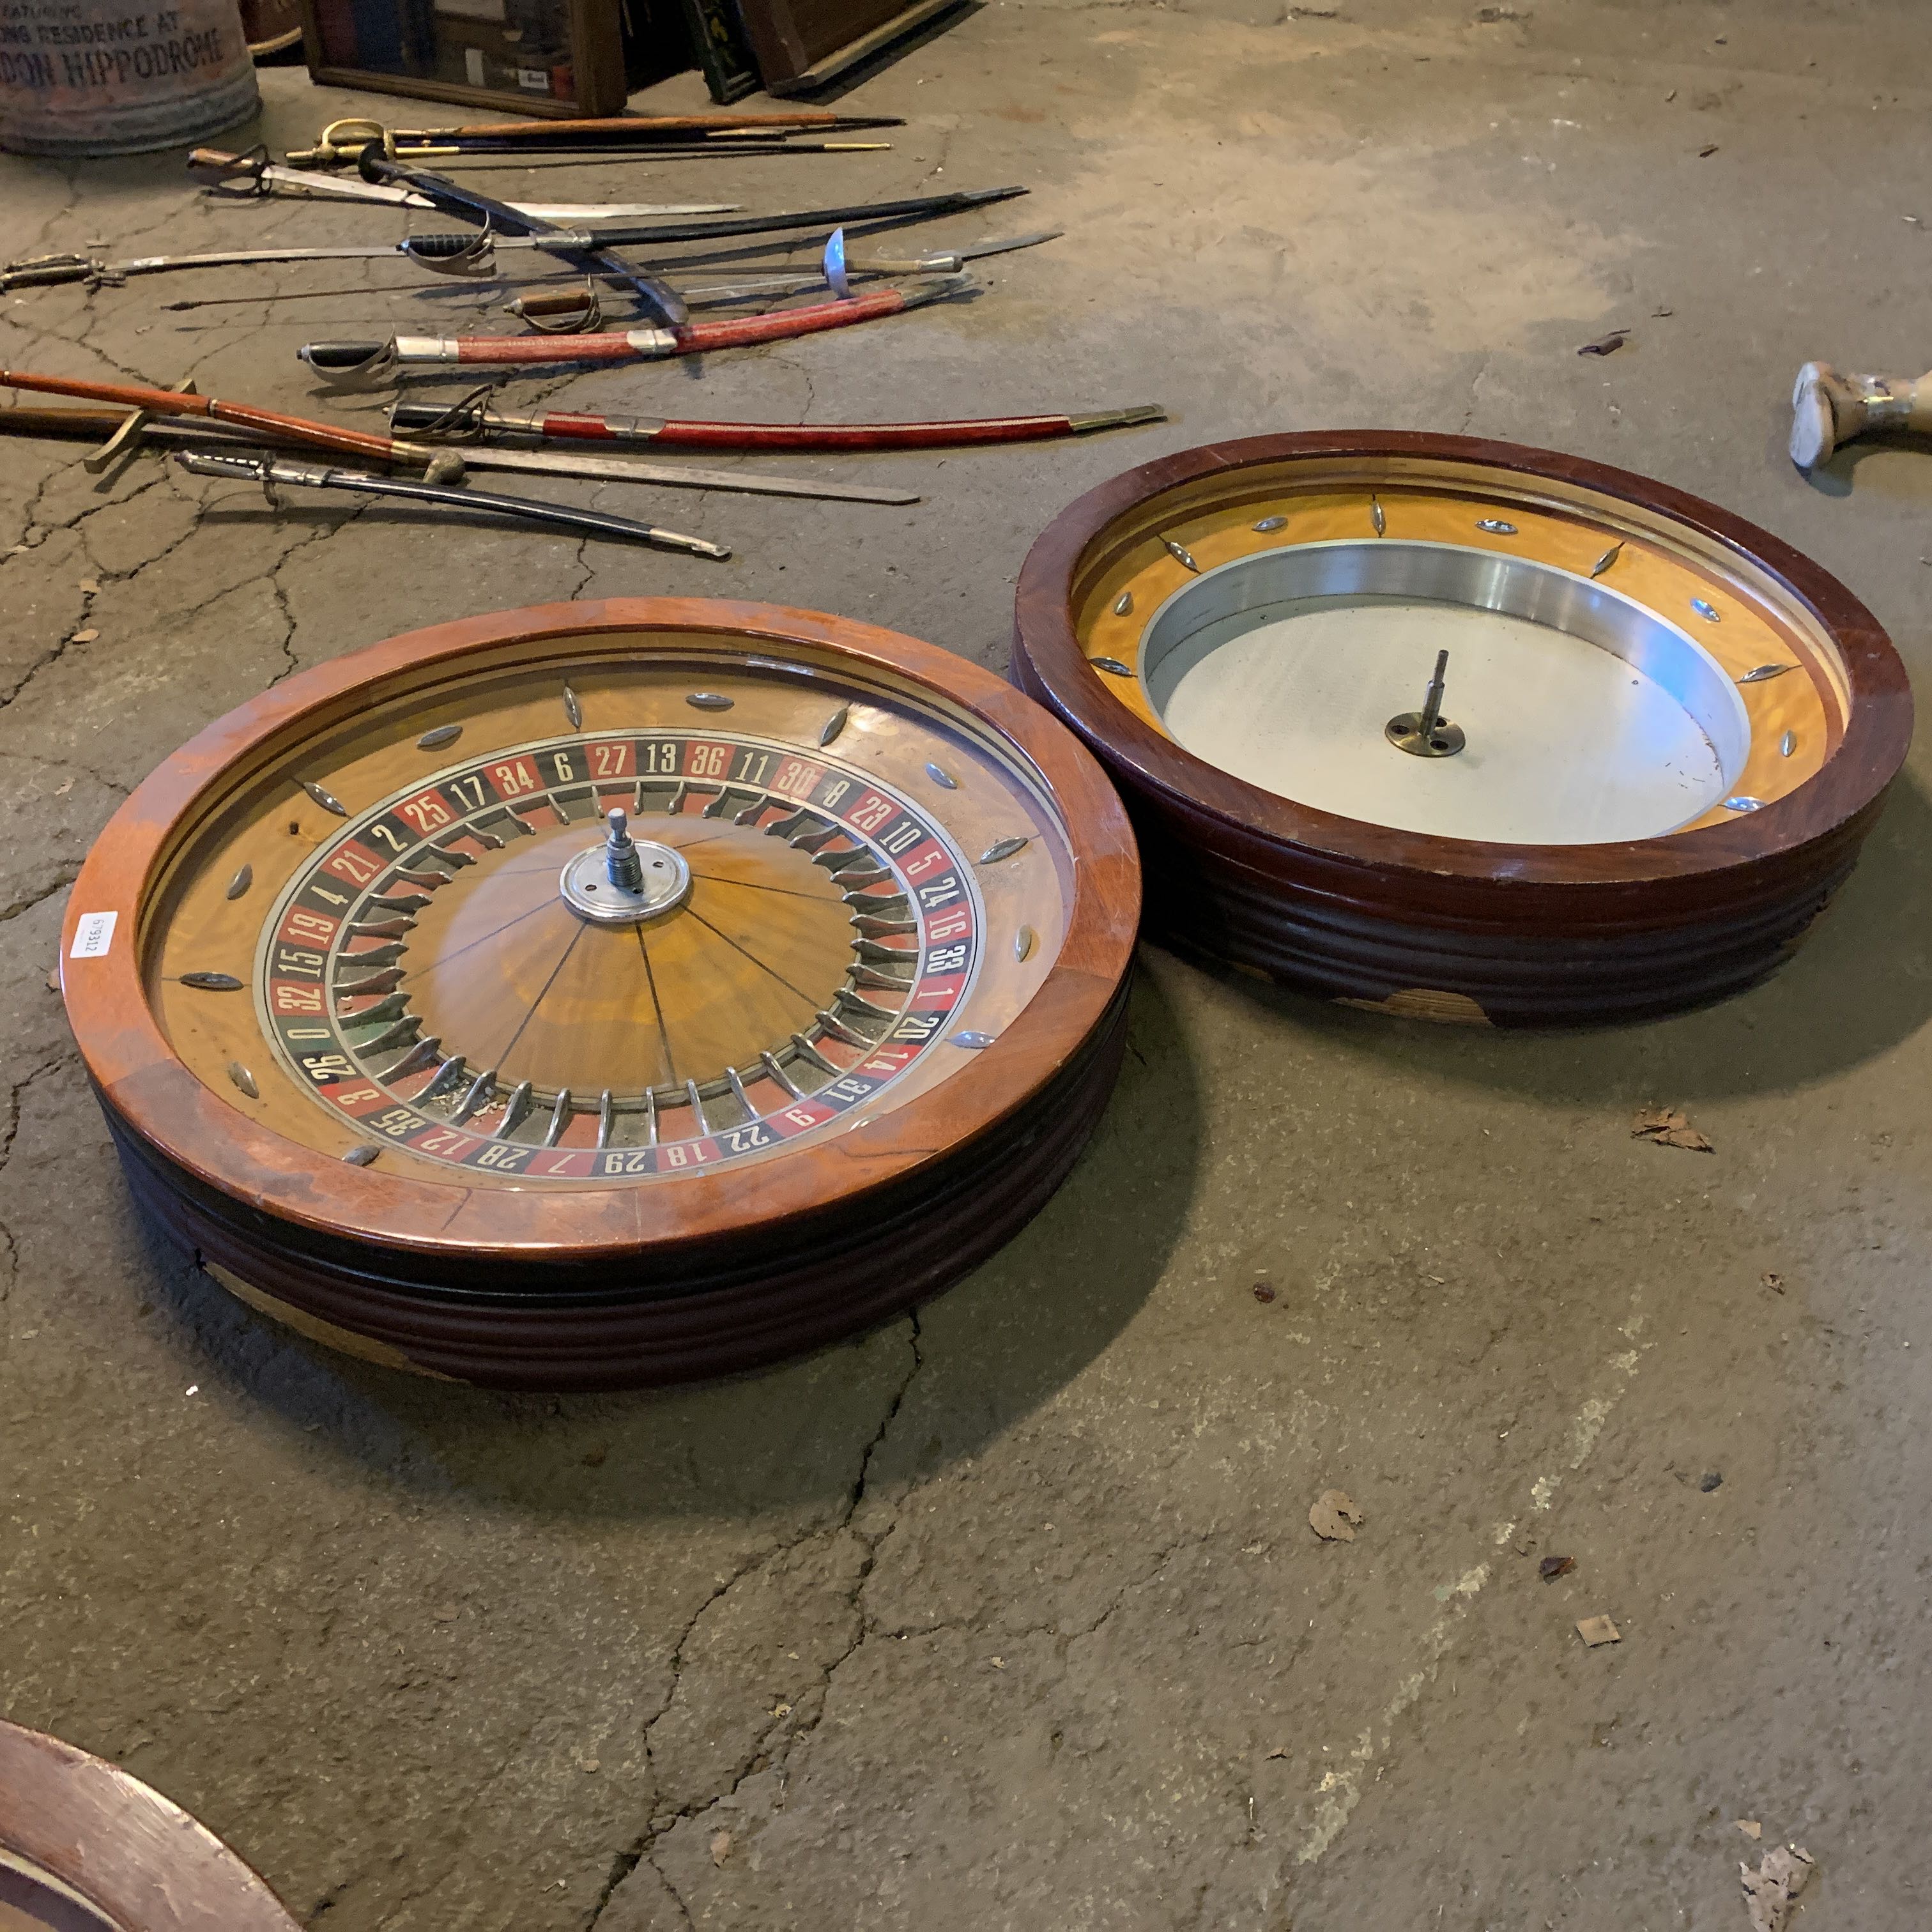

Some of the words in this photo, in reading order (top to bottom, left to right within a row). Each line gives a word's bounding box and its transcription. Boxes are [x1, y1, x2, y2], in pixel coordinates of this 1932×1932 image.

[37, 15, 148, 45] RESIDENCE
[157, 11, 179, 34] AT
[63, 27, 224, 88] HIPPODROME
[554, 753, 573, 781] 6
[595, 746, 627, 775] 27
[646, 744, 675, 773] 13
[691, 745, 725, 776] 36
[735, 752, 769, 785] 11
[496, 762, 533, 795] 34
[778, 762, 815, 793] 30
[450, 776, 486, 811] 17
[823, 780, 850, 808] 8
[404, 796, 450, 832] 25
[850, 797, 891, 831] 23
[371, 824, 408, 852] 2
[879, 821, 921, 854] 10
[332, 850, 379, 883] 21
[907, 851, 942, 875] 5
[310, 885, 349, 906] 4
[919, 877, 959, 908] 24
[288, 914, 334, 944] 19
[929, 910, 967, 940] 16
[278, 949, 323, 978] 15
[927, 944, 966, 973] 33
[277, 986, 322, 1011] 32
[917, 988, 954, 999] 1
[287, 1029, 331, 1039] 0
[893, 1016, 939, 1039] 20
[302, 1054, 357, 1080] 26
[863, 1050, 909, 1072] 14
[823, 1078, 872, 1102] 31
[370, 1109, 427, 1136] 35
[785, 1109, 816, 1127] 9
[420, 1130, 475, 1155] 12
[723, 1126, 770, 1152] 22
[478, 1145, 529, 1169] 28
[548, 1154, 576, 1174] 7
[605, 1151, 646, 1173] 29
[667, 1142, 707, 1167] 18
